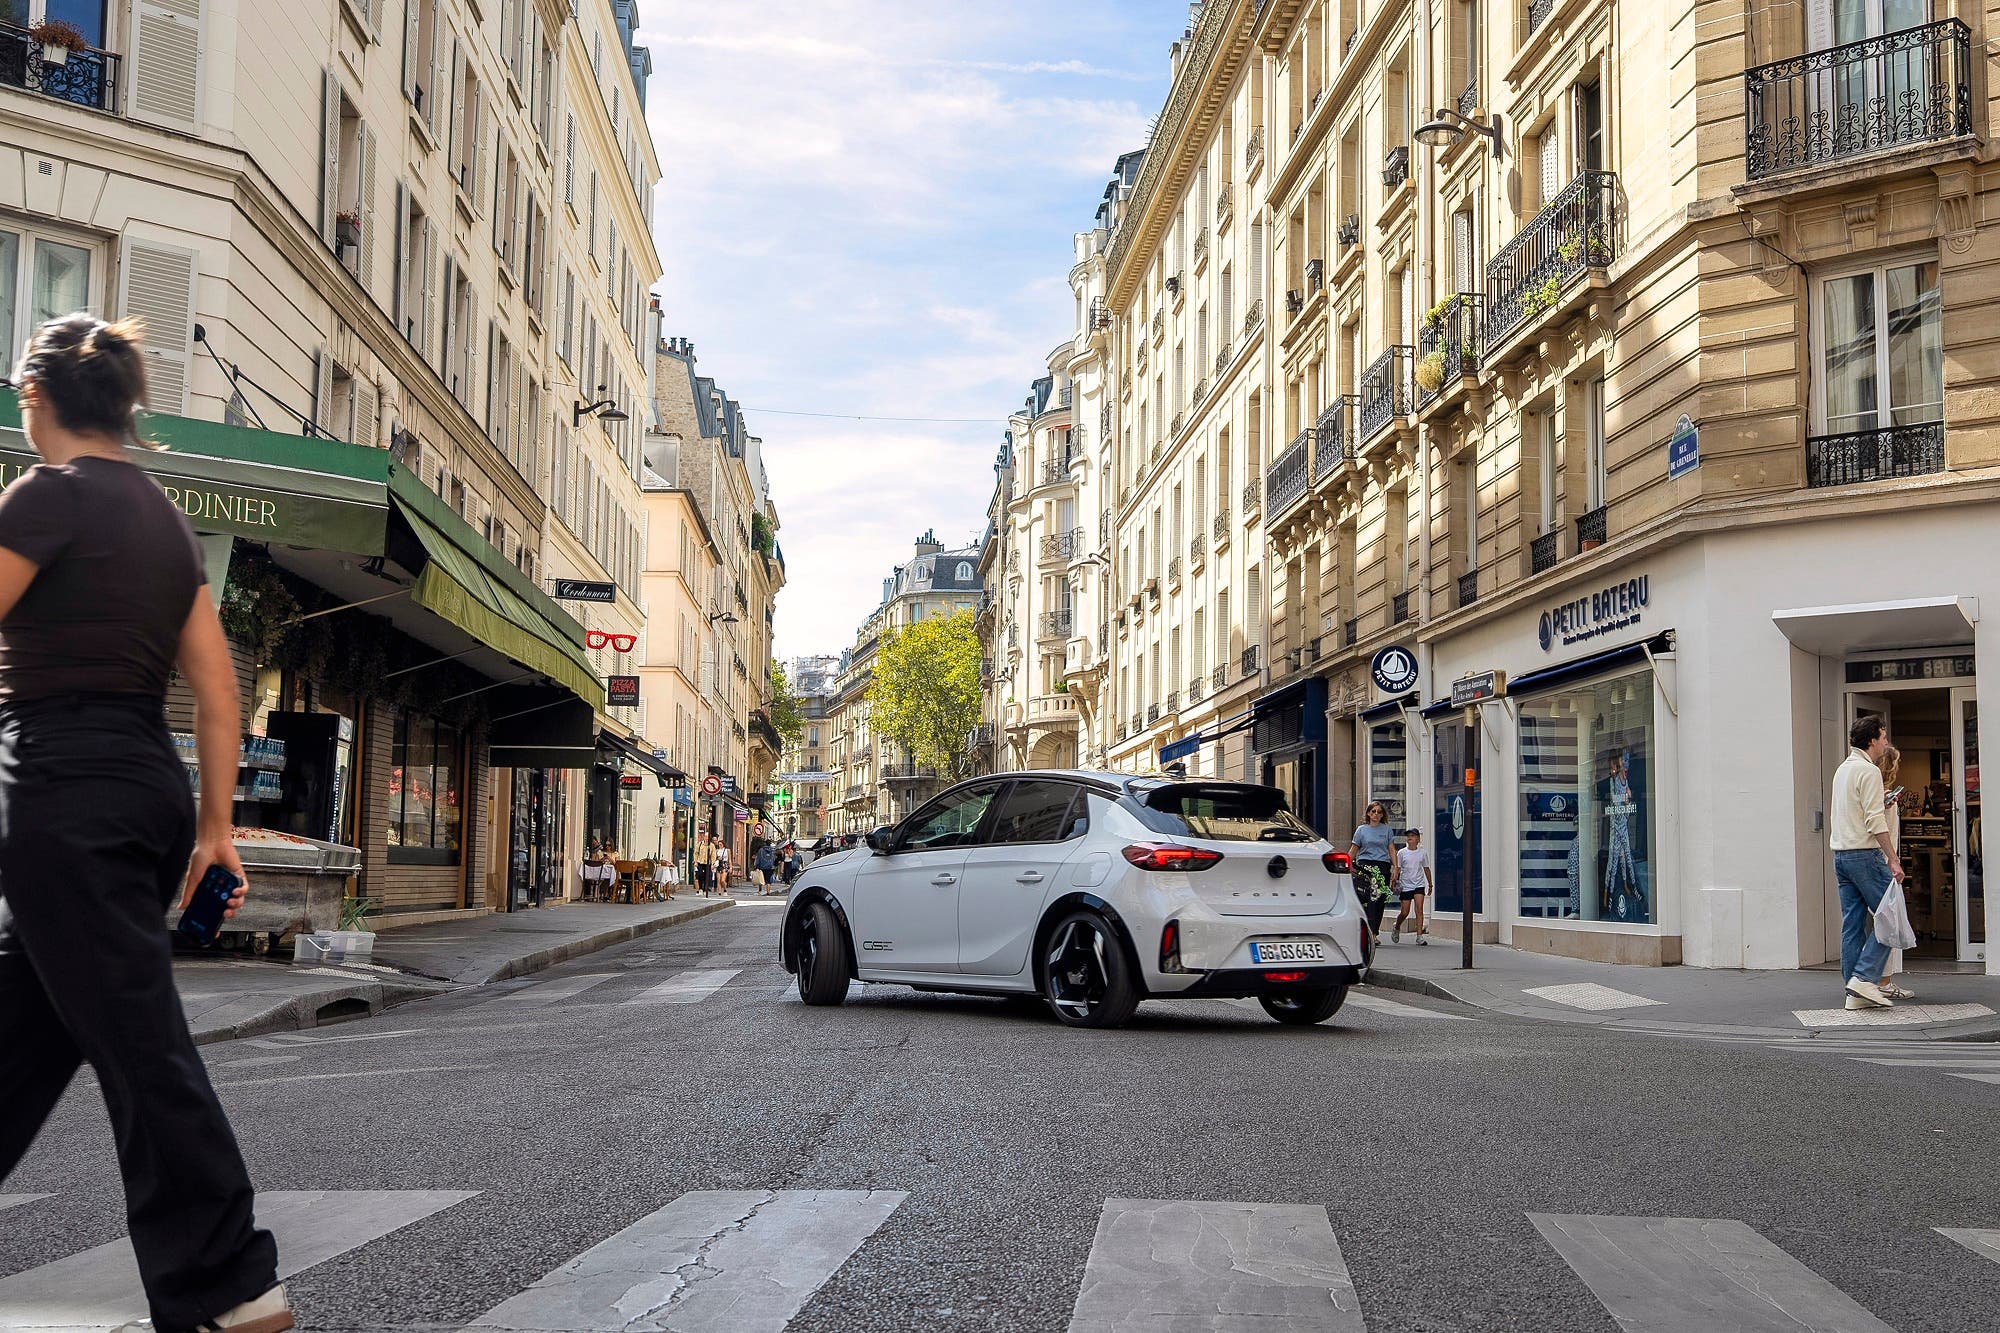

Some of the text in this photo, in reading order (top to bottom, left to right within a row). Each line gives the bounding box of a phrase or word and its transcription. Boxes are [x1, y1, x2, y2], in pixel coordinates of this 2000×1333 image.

[1678, 443, 1688, 455] RUE
[1670, 450, 1697, 471] DE GRENELLE
[163, 486, 278, 527] RDINIER
[561, 583, 612, 599] Cordonnerie
[1552, 574, 1649, 635] PETIT BATEAU
[1872, 658, 1976, 678] PETIT BATEA
[1374, 669, 1417, 690] PETIT BATEAU
[610, 685, 637, 693] PASTA
[621, 776, 641, 784] PIZZA
[1259, 943, 1324, 960] GG GS 643E
